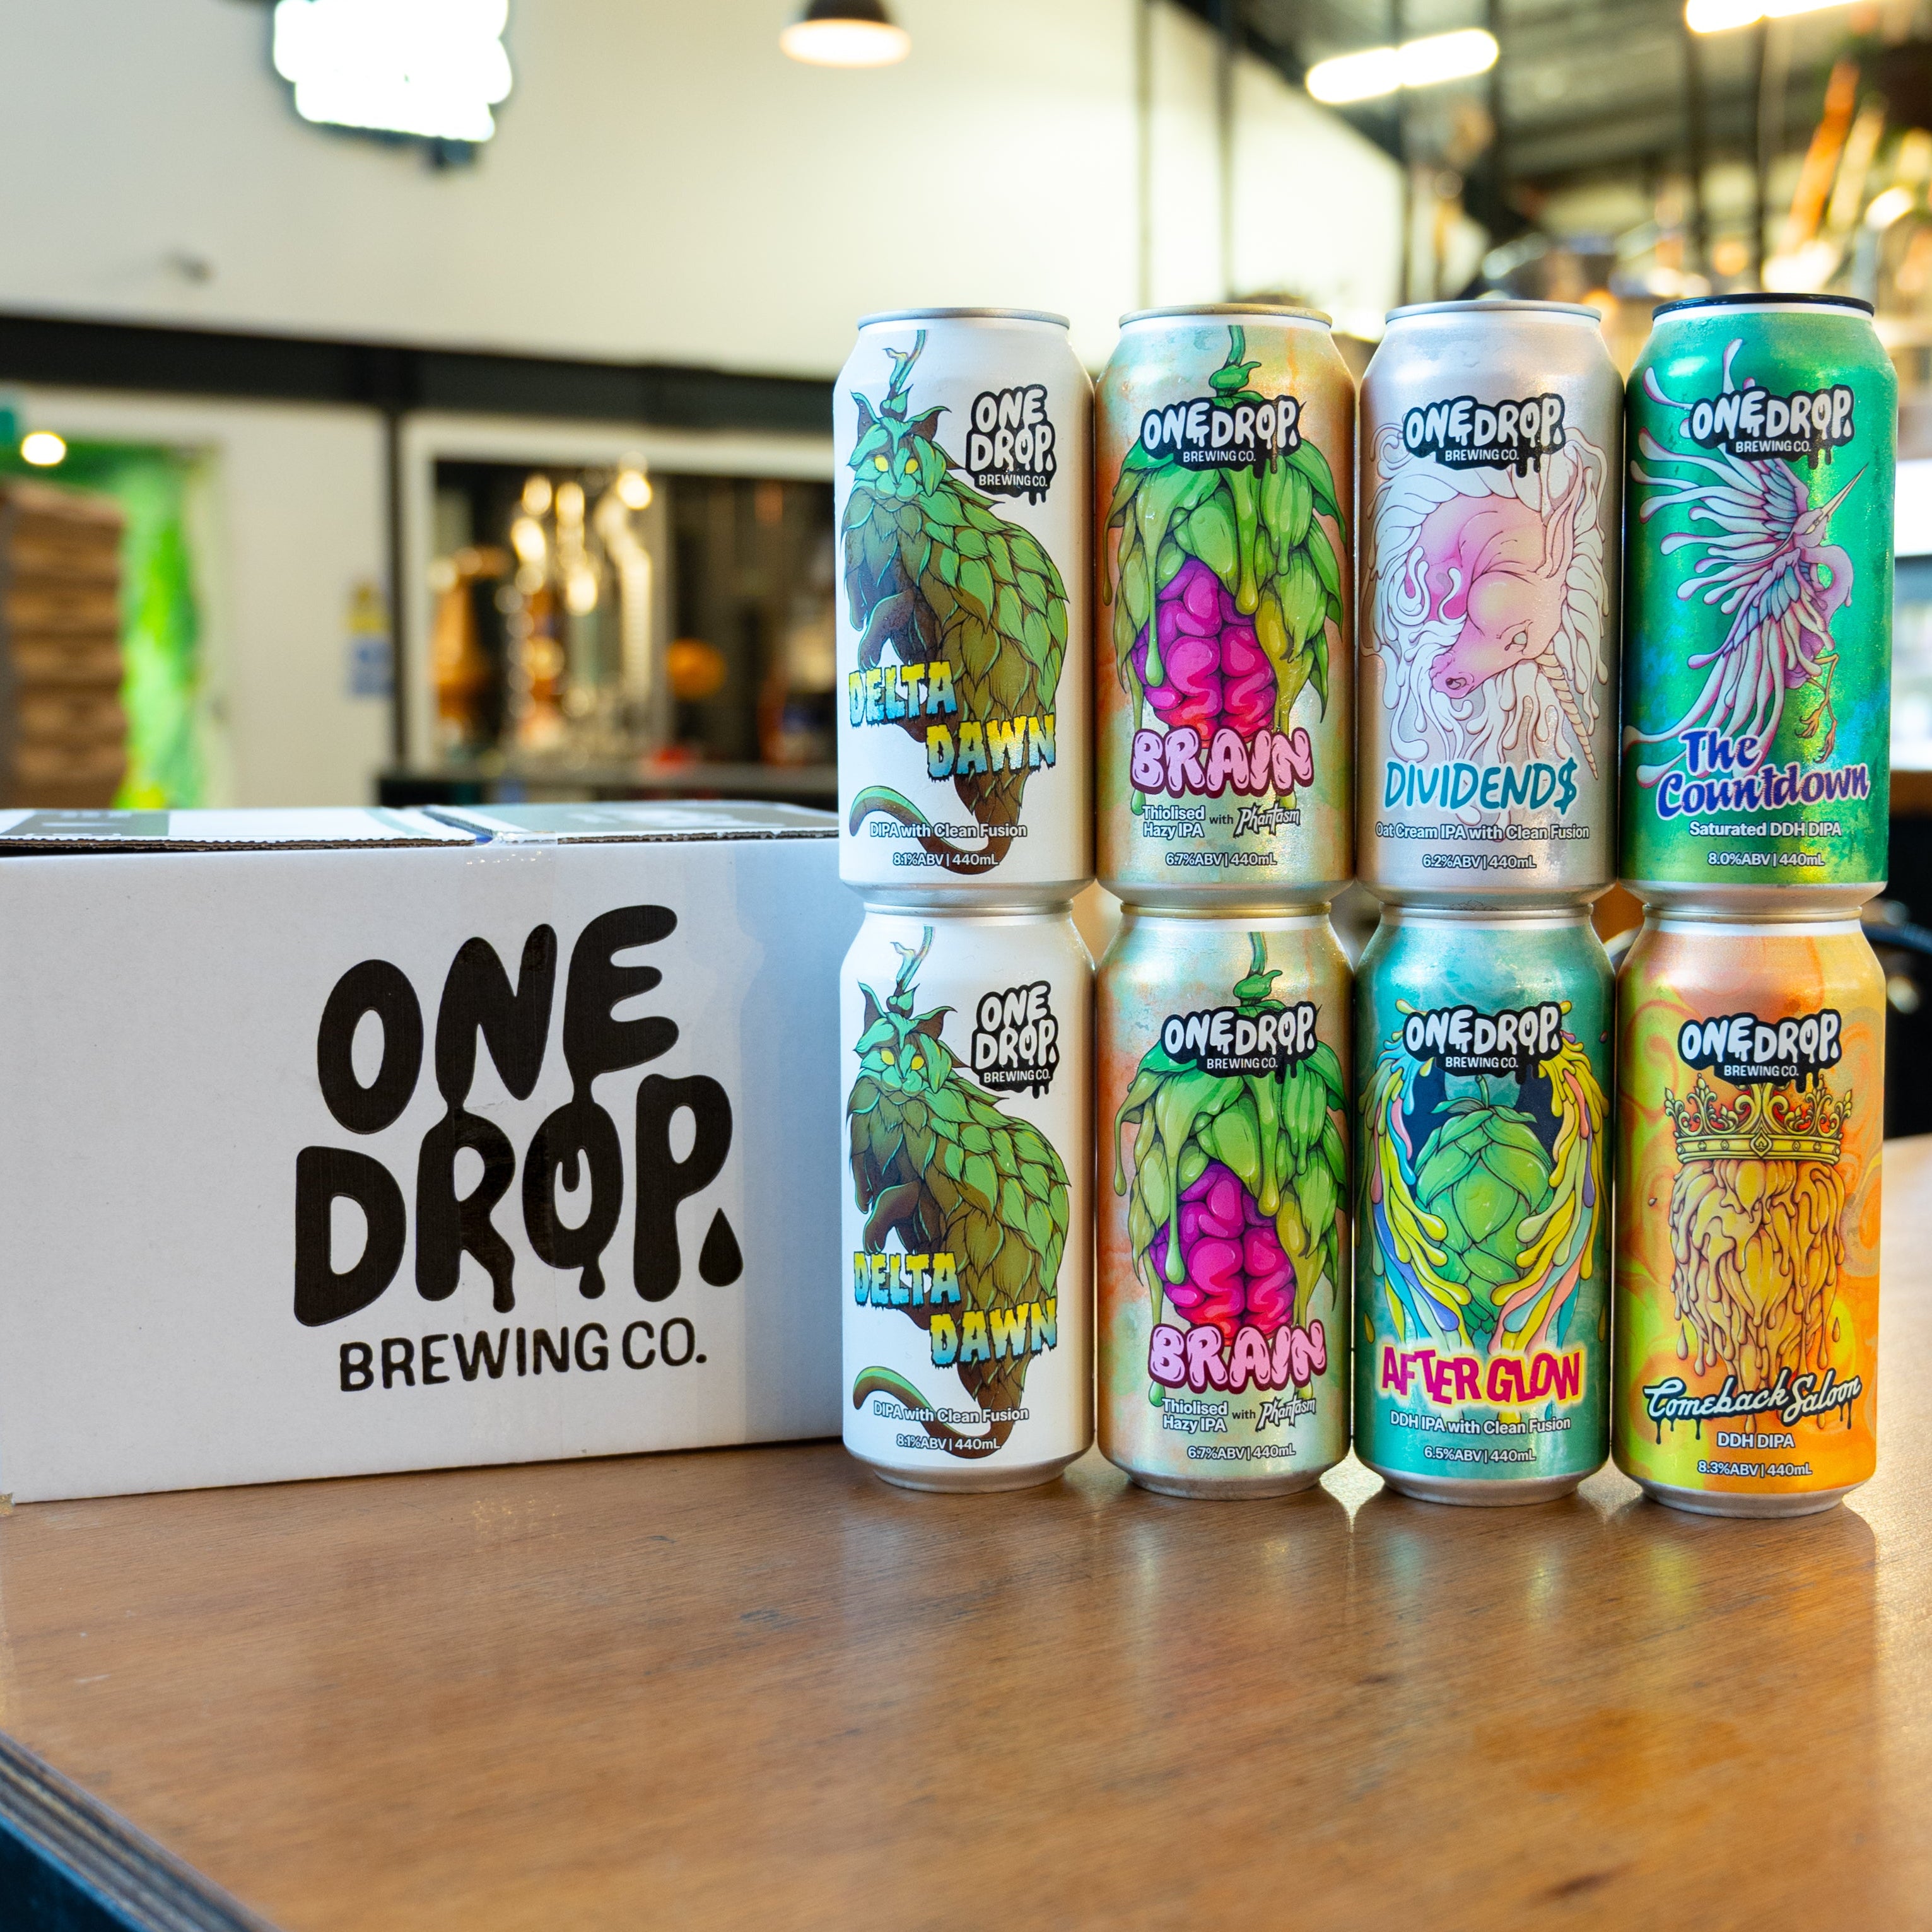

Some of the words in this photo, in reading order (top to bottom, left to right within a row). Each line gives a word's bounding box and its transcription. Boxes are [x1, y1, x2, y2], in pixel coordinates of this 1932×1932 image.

[976, 389, 1044, 433] ONE
[1692, 390, 1765, 440] ONE
[1144, 402, 1210, 450] ONE
[1406, 400, 1473, 448] ONE
[1183, 450, 1236, 462] BREWING
[1238, 450, 1256, 462] CO.
[1445, 449, 1499, 461] BREWING
[1501, 449, 1519, 460] CO.
[1736, 440, 1791, 453] BREWING
[1793, 440, 1812, 452] CO.
[979, 474, 1031, 486] BREWING
[1033, 476, 1047, 486] CO.
[849, 661, 957, 727] DELTA
[926, 713, 1056, 781] DAWN
[1679, 727, 1759, 776] The
[1130, 725, 1314, 799] BRAIN
[1656, 762, 1870, 820] Countdown
[1142, 805, 1205, 821] Thiolised
[1209, 814, 1234, 824] with
[1232, 800, 1301, 838] Phantasm
[870, 823, 899, 837] DIPA
[900, 823, 931, 837] with
[934, 823, 977, 838] Clean
[979, 823, 1027, 838] Fusion
[1143, 821, 1176, 840] Hazy
[1178, 823, 1204, 837] IPA
[1375, 821, 1394, 837] Oat
[1395, 823, 1437, 839] Cream
[1440, 824, 1467, 840] IPA
[1468, 826, 1504, 840] with
[1506, 825, 1549, 840] Clean
[1550, 824, 1590, 840] Fusion
[1689, 821, 1766, 837] Saturated
[1770, 823, 1805, 837] DDH
[1808, 823, 1842, 837] DIPA
[952, 853, 1000, 866] 440mL
[1230, 853, 1277, 866] 440mL
[1489, 855, 1537, 869] 440mL
[1779, 853, 1825, 867] 440mL
[981, 985, 1047, 1032] ONE
[317, 905, 679, 1134] ONE
[1164, 1011, 1234, 1056] ONE
[1406, 1009, 1473, 1054] ONE
[1682, 1017, 1753, 1063] ONE
[1207, 1058, 1260, 1069] BREWING
[1262, 1058, 1278, 1068] CO.
[1445, 1057, 1499, 1068] BREWING
[1501, 1057, 1518, 1068] CO.
[1724, 1065, 1779, 1077] BREWING
[1781, 1065, 1799, 1077] CO.
[983, 1070, 1034, 1083] BREWING
[1035, 1068, 1051, 1080] CO.
[853, 1251, 961, 1308] DELTA
[930, 1296, 1057, 1369] DAWN
[340, 1323, 609, 1391] BREWING
[622, 1318, 706, 1369] CO.
[1148, 1319, 1327, 1394] BRAIN
[1642, 1366, 1791, 1423] Comeback
[1781, 1367, 1862, 1427] Saloon
[874, 1400, 903, 1419] DIPA
[903, 1407, 935, 1422] with
[937, 1408, 980, 1424] Clean
[982, 1407, 1029, 1424] Fusion
[1161, 1398, 1228, 1415] Thiolised
[1232, 1410, 1255, 1419] with
[1255, 1390, 1316, 1432] Phantasm
[1162, 1415, 1198, 1433] Hazy
[1200, 1417, 1227, 1432] IPA
[1390, 1410, 1419, 1429] DDH
[1421, 1416, 1446, 1432] IPA
[1446, 1419, 1481, 1434] with
[1483, 1420, 1526, 1435] Clean
[1528, 1417, 1571, 1434] Fusion
[954, 1436, 1000, 1450] 440mL
[1717, 1432, 1754, 1448] DDH
[1757, 1433, 1795, 1449] DIPA
[1253, 1444, 1296, 1458] 440mL
[1490, 1449, 1537, 1462] 440mL
[1767, 1463, 1812, 1477] 440mL
